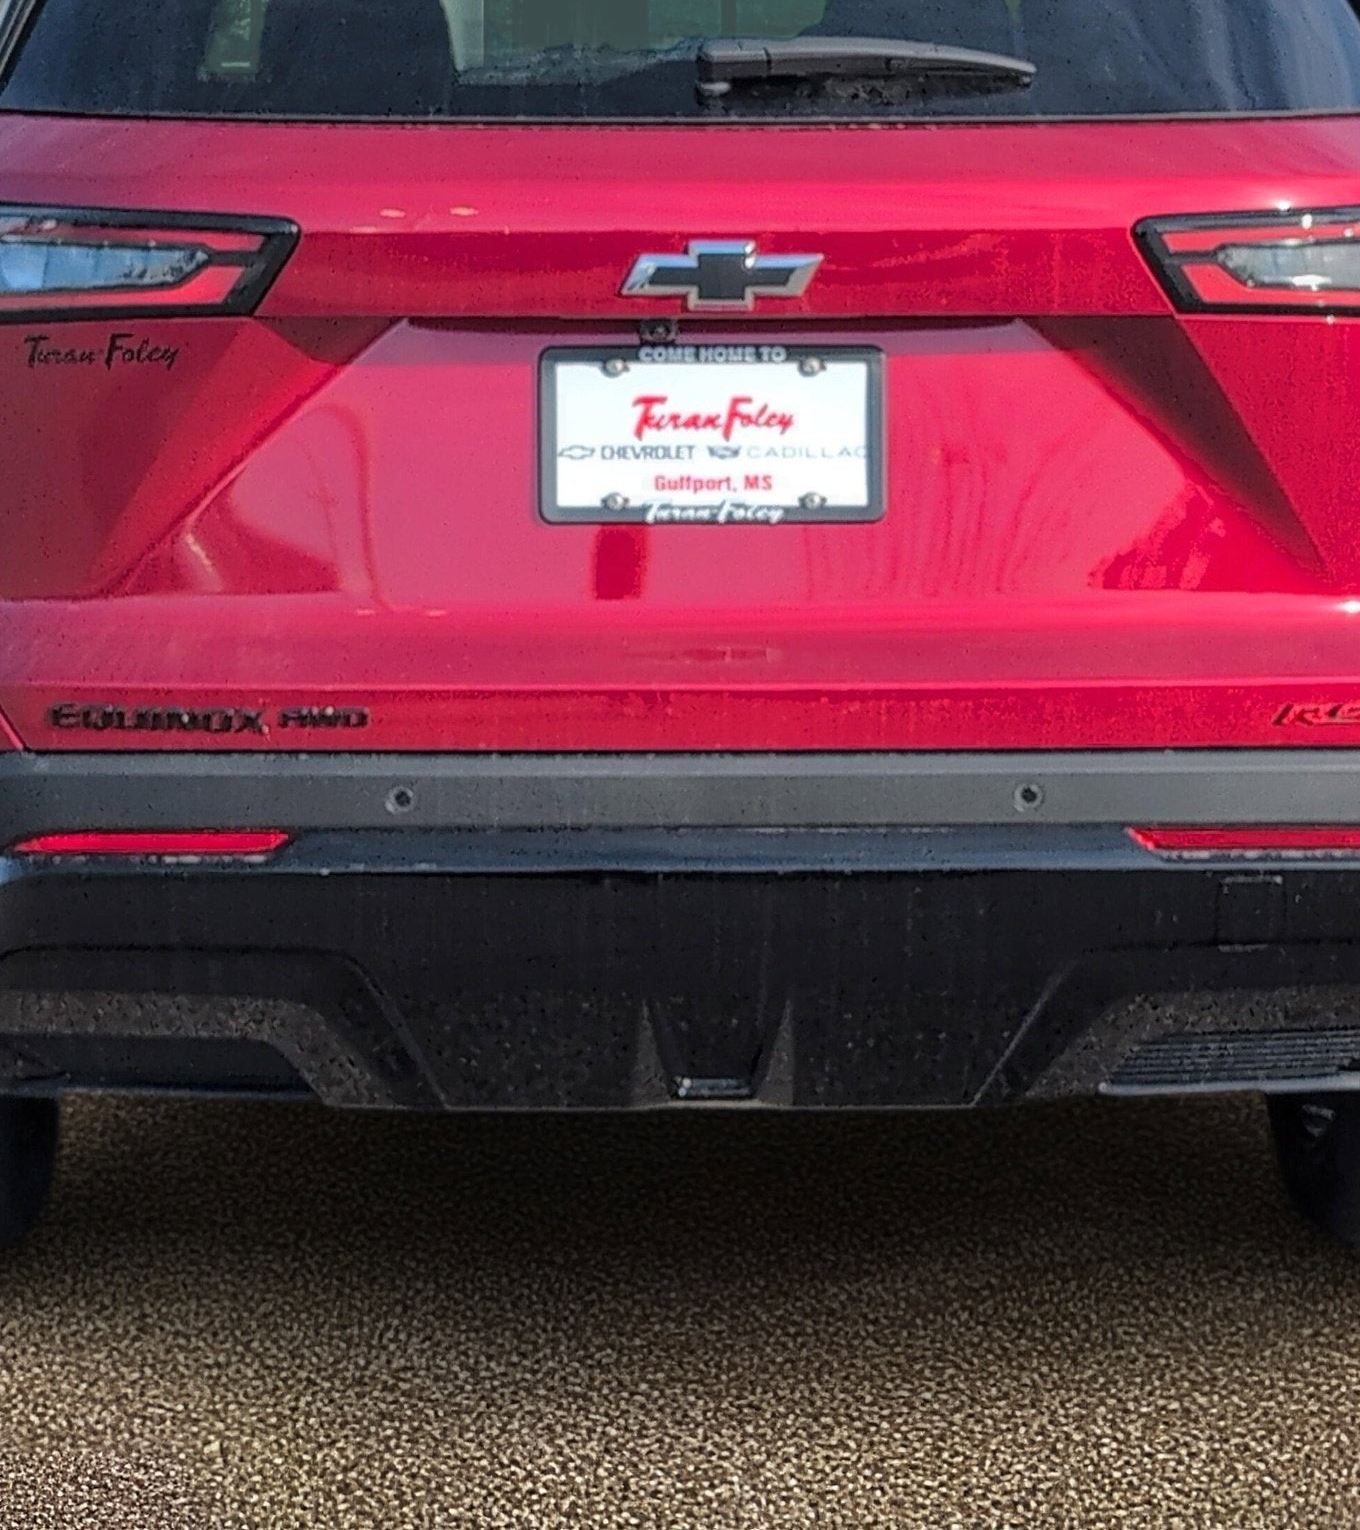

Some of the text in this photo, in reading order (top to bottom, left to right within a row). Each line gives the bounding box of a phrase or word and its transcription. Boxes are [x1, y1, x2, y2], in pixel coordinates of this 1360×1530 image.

[24, 332, 180, 371] Turan Foley
[639, 346, 788, 363] COME HOME TO
[632, 396, 795, 442] Turan Foley
[600, 444, 696, 460] CHEVROLET
[743, 474, 773, 491] MS
[47, 701, 265, 733] EQUINOX
